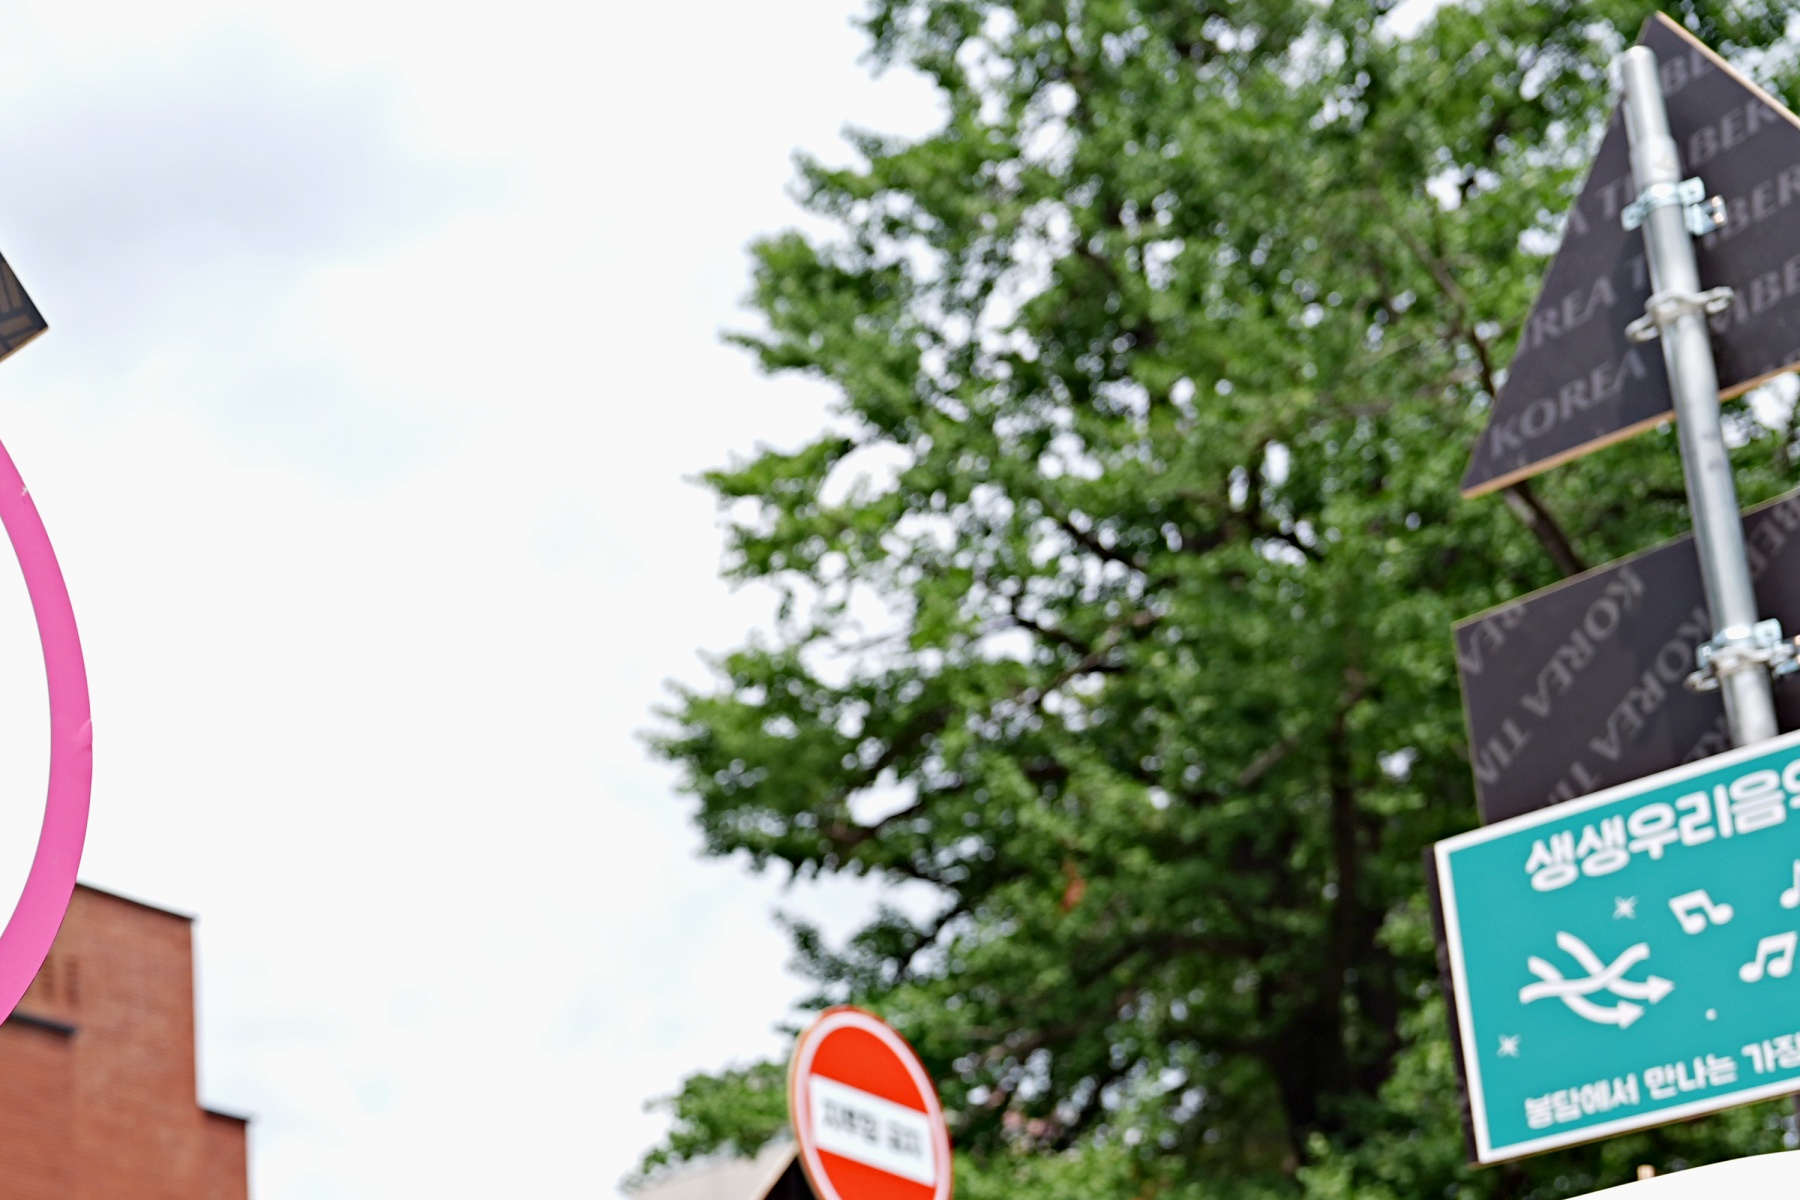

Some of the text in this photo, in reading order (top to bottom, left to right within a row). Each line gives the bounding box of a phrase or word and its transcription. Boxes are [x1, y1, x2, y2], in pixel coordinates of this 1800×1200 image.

[1489, 349, 1647, 459] KOREA
[1520, 564, 1646, 718] KOREA
[1643, 1053, 1738, 1101] 만나는
